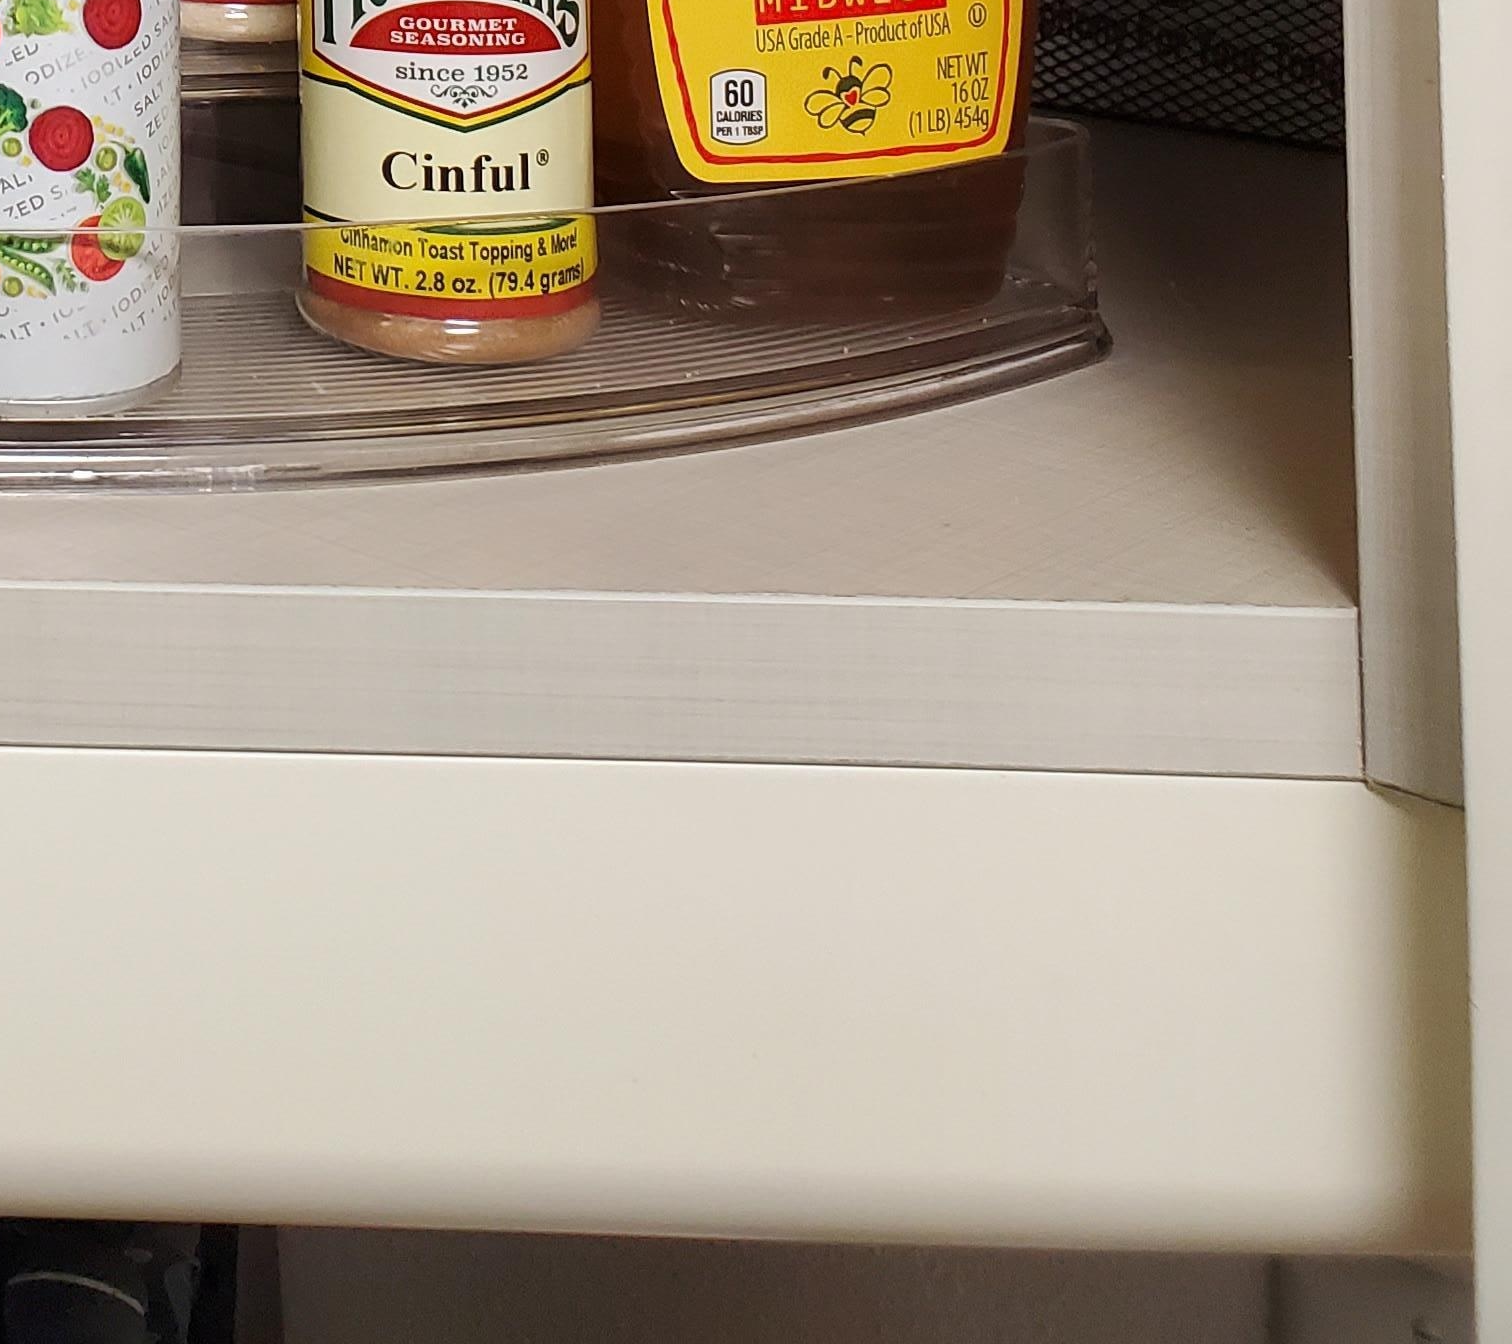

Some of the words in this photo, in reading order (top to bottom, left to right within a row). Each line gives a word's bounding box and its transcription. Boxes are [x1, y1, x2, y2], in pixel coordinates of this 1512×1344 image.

[399, 16, 518, 32] GOURMET
[755, 28, 786, 54] USA
[788, 27, 830, 53] Grade
[832, 26, 844, 48] A
[855, 21, 908, 46] Product
[907, 19, 925, 41] of
[925, 13, 951, 38] USA
[390, 30, 526, 47] SEASONING
[395, 62, 465, 83] since
[473, 63, 529, 83] 1952
[936, 54, 963, 79] NET
[964, 52, 989, 76] WT
[724, 79, 754, 108] 60
[951, 81, 968, 105] 16
[972, 77, 989, 101] OZ
[716, 110, 763, 123] CALORIES
[908, 112, 925, 138] (1
[926, 108, 951, 135] LB)
[954, 106, 989, 132] 454g
[716, 126, 732, 138] PER
[741, 125, 764, 137] TBSP
[418, 236, 465, 261] Toast
[468, 239, 534, 266] Topping
[537, 236, 548, 256] &
[550, 226, 578, 255] More!
[333, 253, 367, 282] NET
[371, 265, 410, 290] WT.
[414, 269, 445, 292] 2.8
[451, 276, 483, 294] oz.
[489, 269, 535, 300] (79.4
